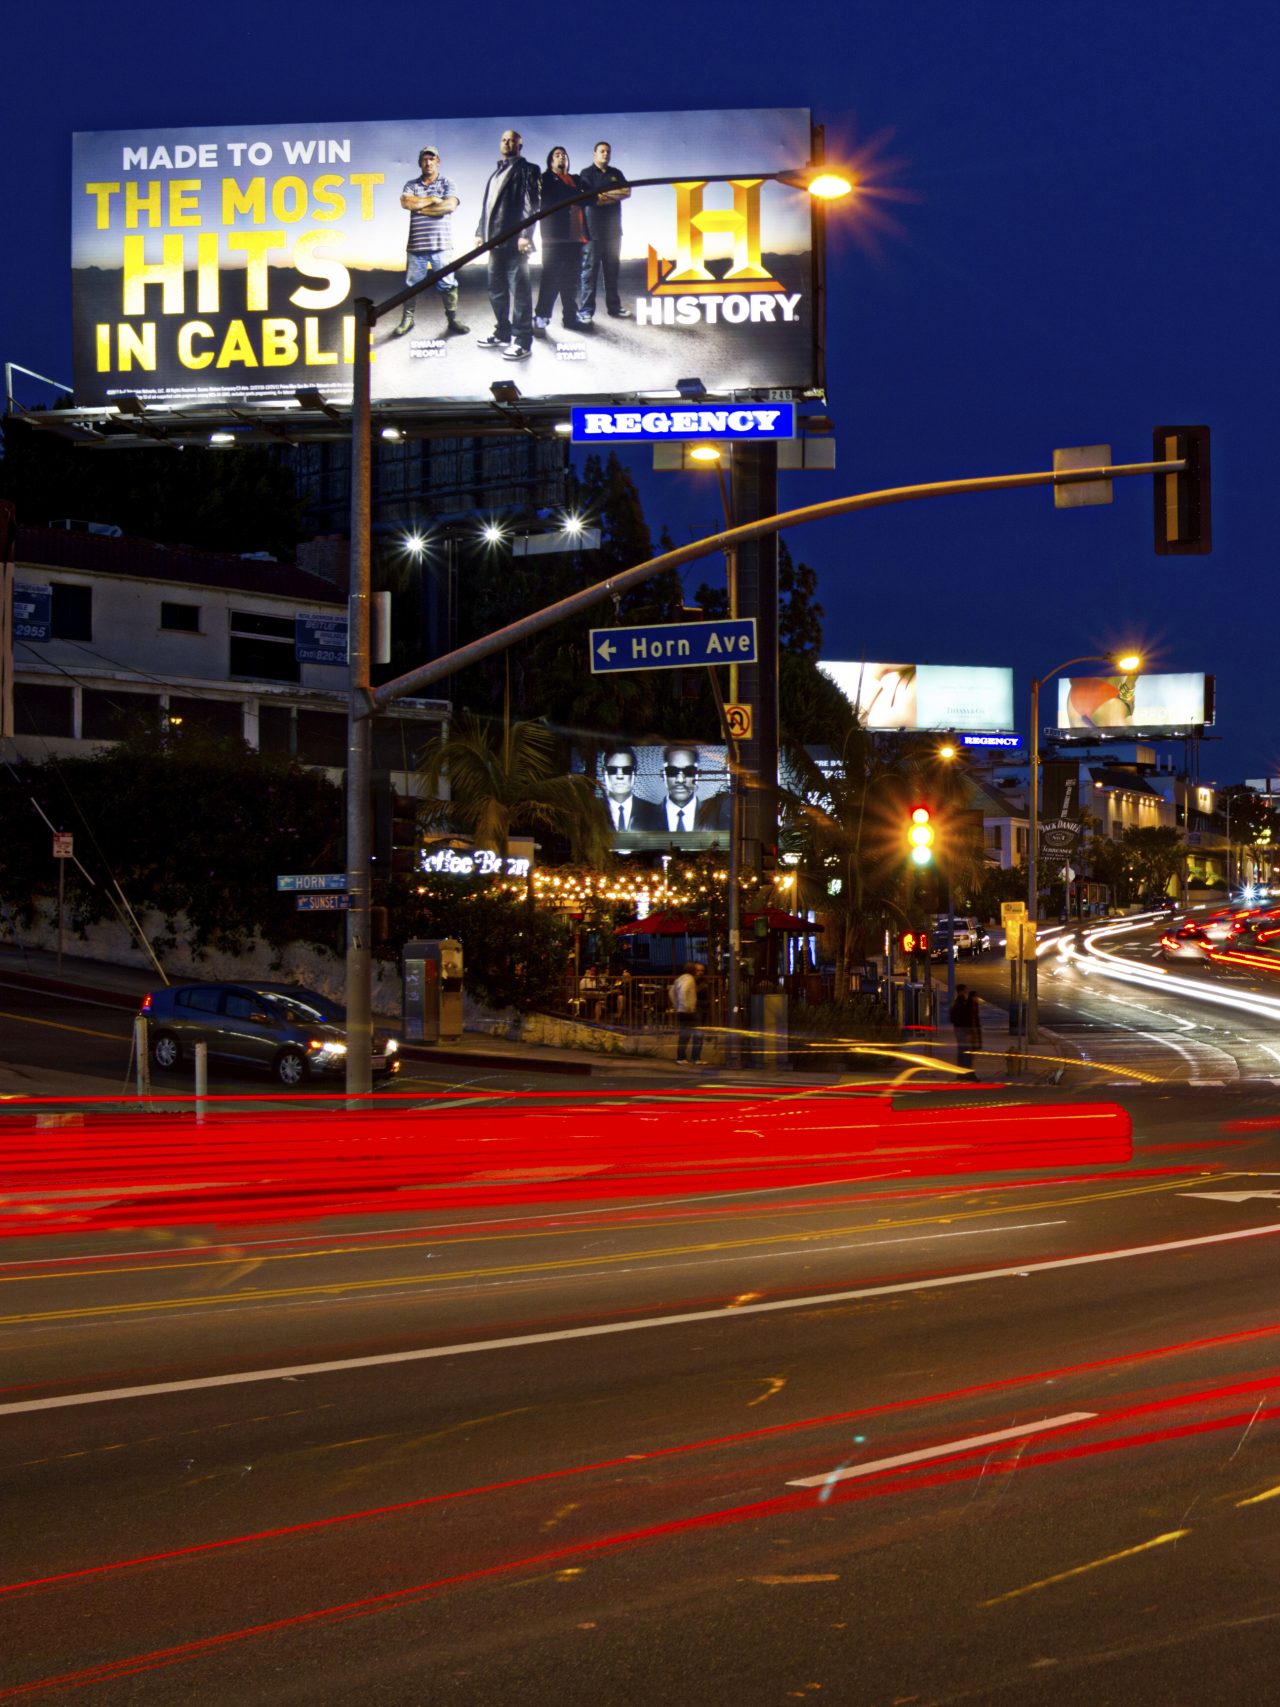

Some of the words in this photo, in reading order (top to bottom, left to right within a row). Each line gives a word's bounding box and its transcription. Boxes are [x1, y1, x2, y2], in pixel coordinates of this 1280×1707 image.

[123, 144, 218, 170] MADE
[227, 142, 272, 167] TO
[282, 140, 351, 165] WIN
[85, 179, 201, 230] THE
[221, 174, 385, 225] MOST
[123, 229, 351, 315] HITS
[636, 293, 801, 325] HISTORY
[96, 322, 156, 372] IN
[584, 411, 780, 434] REGENCY
[631, 637, 690, 659] Horn
[706, 632, 751, 654] Ave
[964, 737, 1019, 746] REGENCY
[414, 849, 473, 873] offee
[296, 876, 325, 889] HORN
[309, 896, 339, 909] SUNSET
